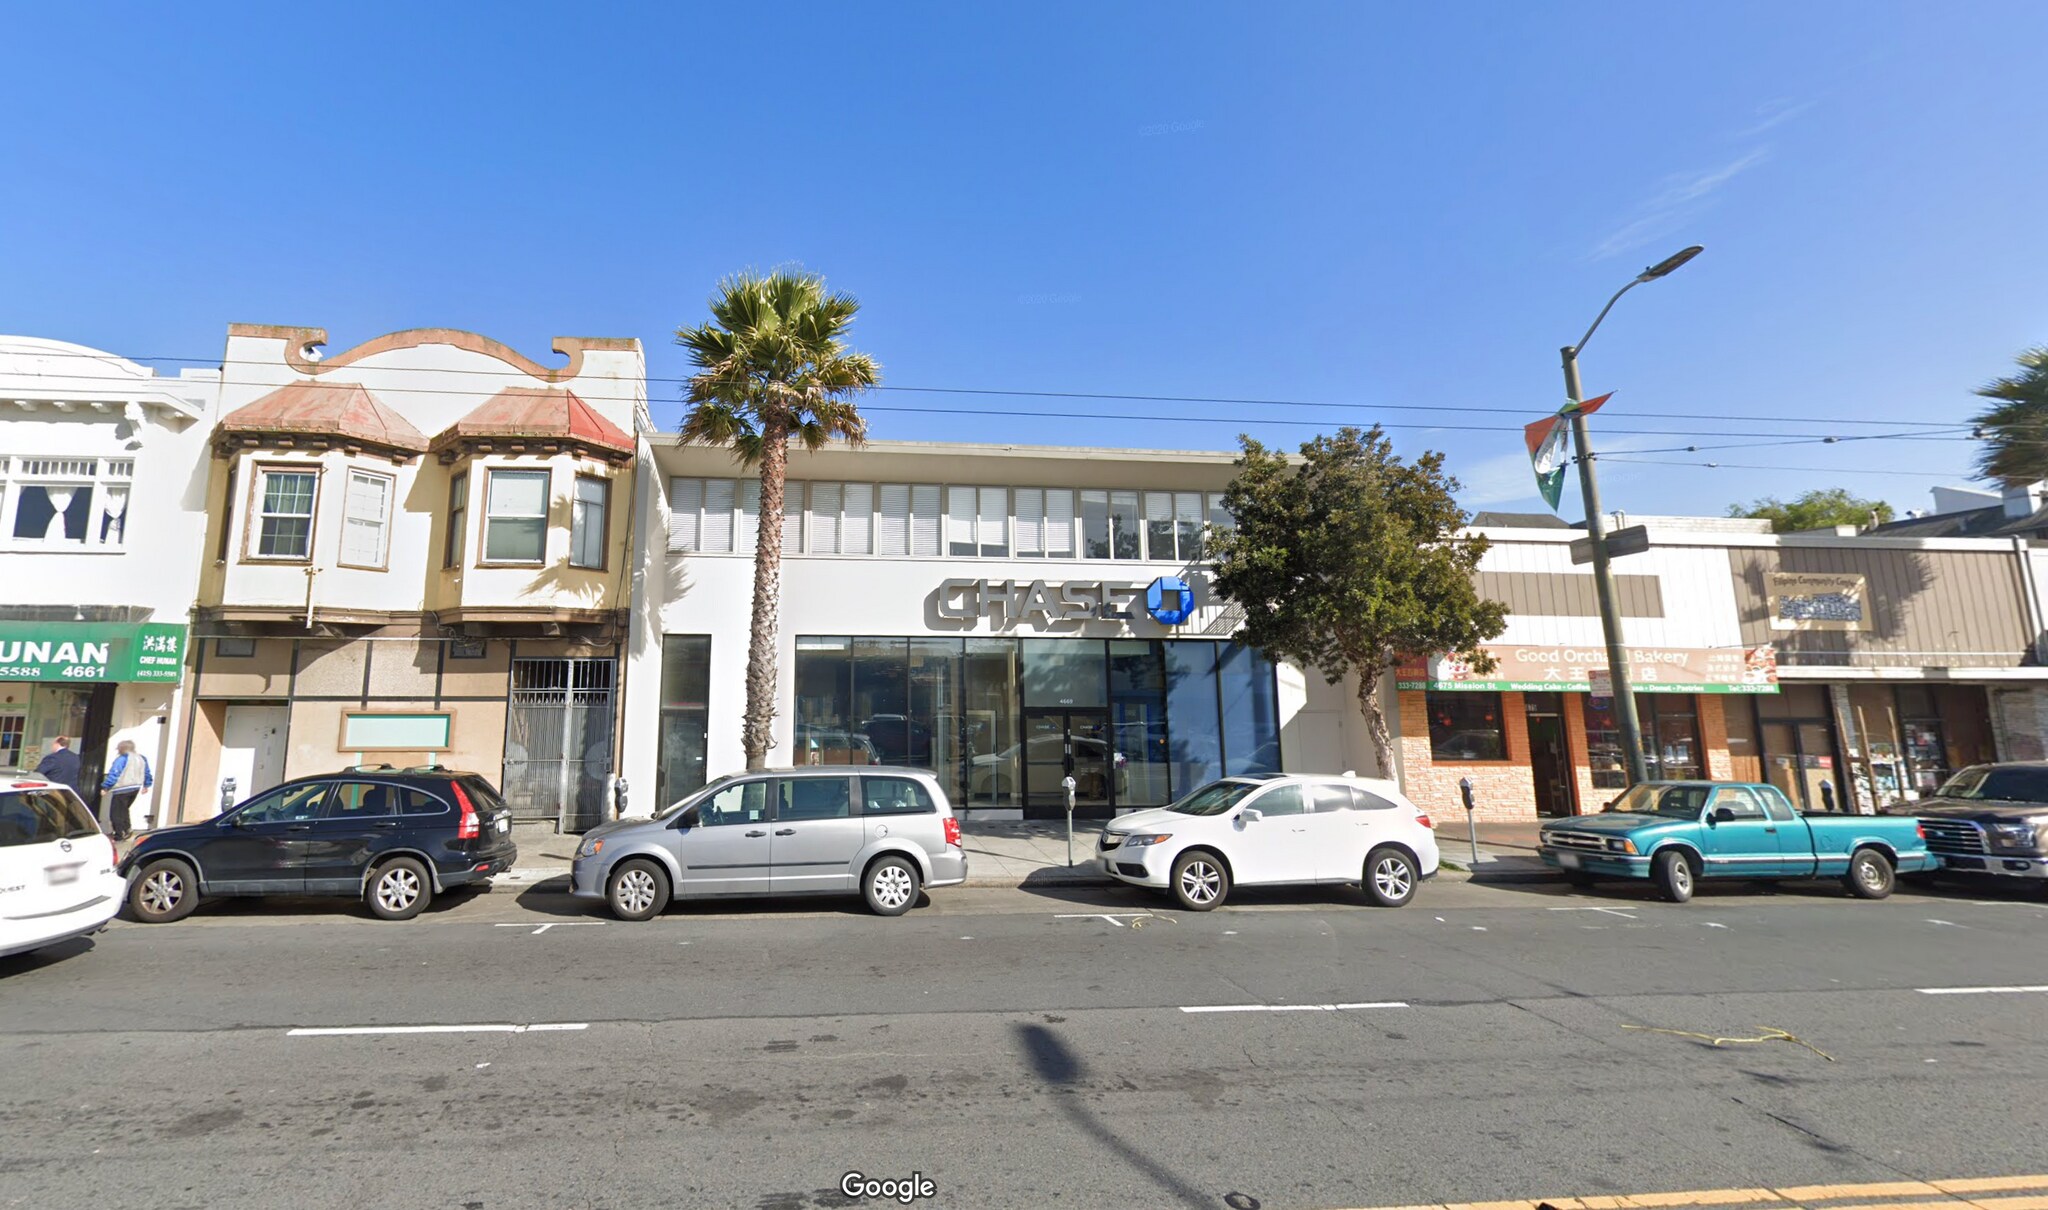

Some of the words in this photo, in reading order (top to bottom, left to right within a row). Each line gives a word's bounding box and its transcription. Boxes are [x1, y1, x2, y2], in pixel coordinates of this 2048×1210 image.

[939, 578, 1135, 620] CHASE
[139, 656, 156, 665] CHEF
[156, 657, 177, 665] HUNAN
[1515, 649, 1560, 663] Good
[1563, 649, 1630, 664] Orcha
[1634, 650, 1688, 667] Bakery
[62, 666, 105, 678] 4661
[1454, 682, 1485, 690] Mission
[1486, 682, 1498, 690] St.
[1510, 683, 1543, 691] Wedding
[1649, 684, 1671, 692] Donut
